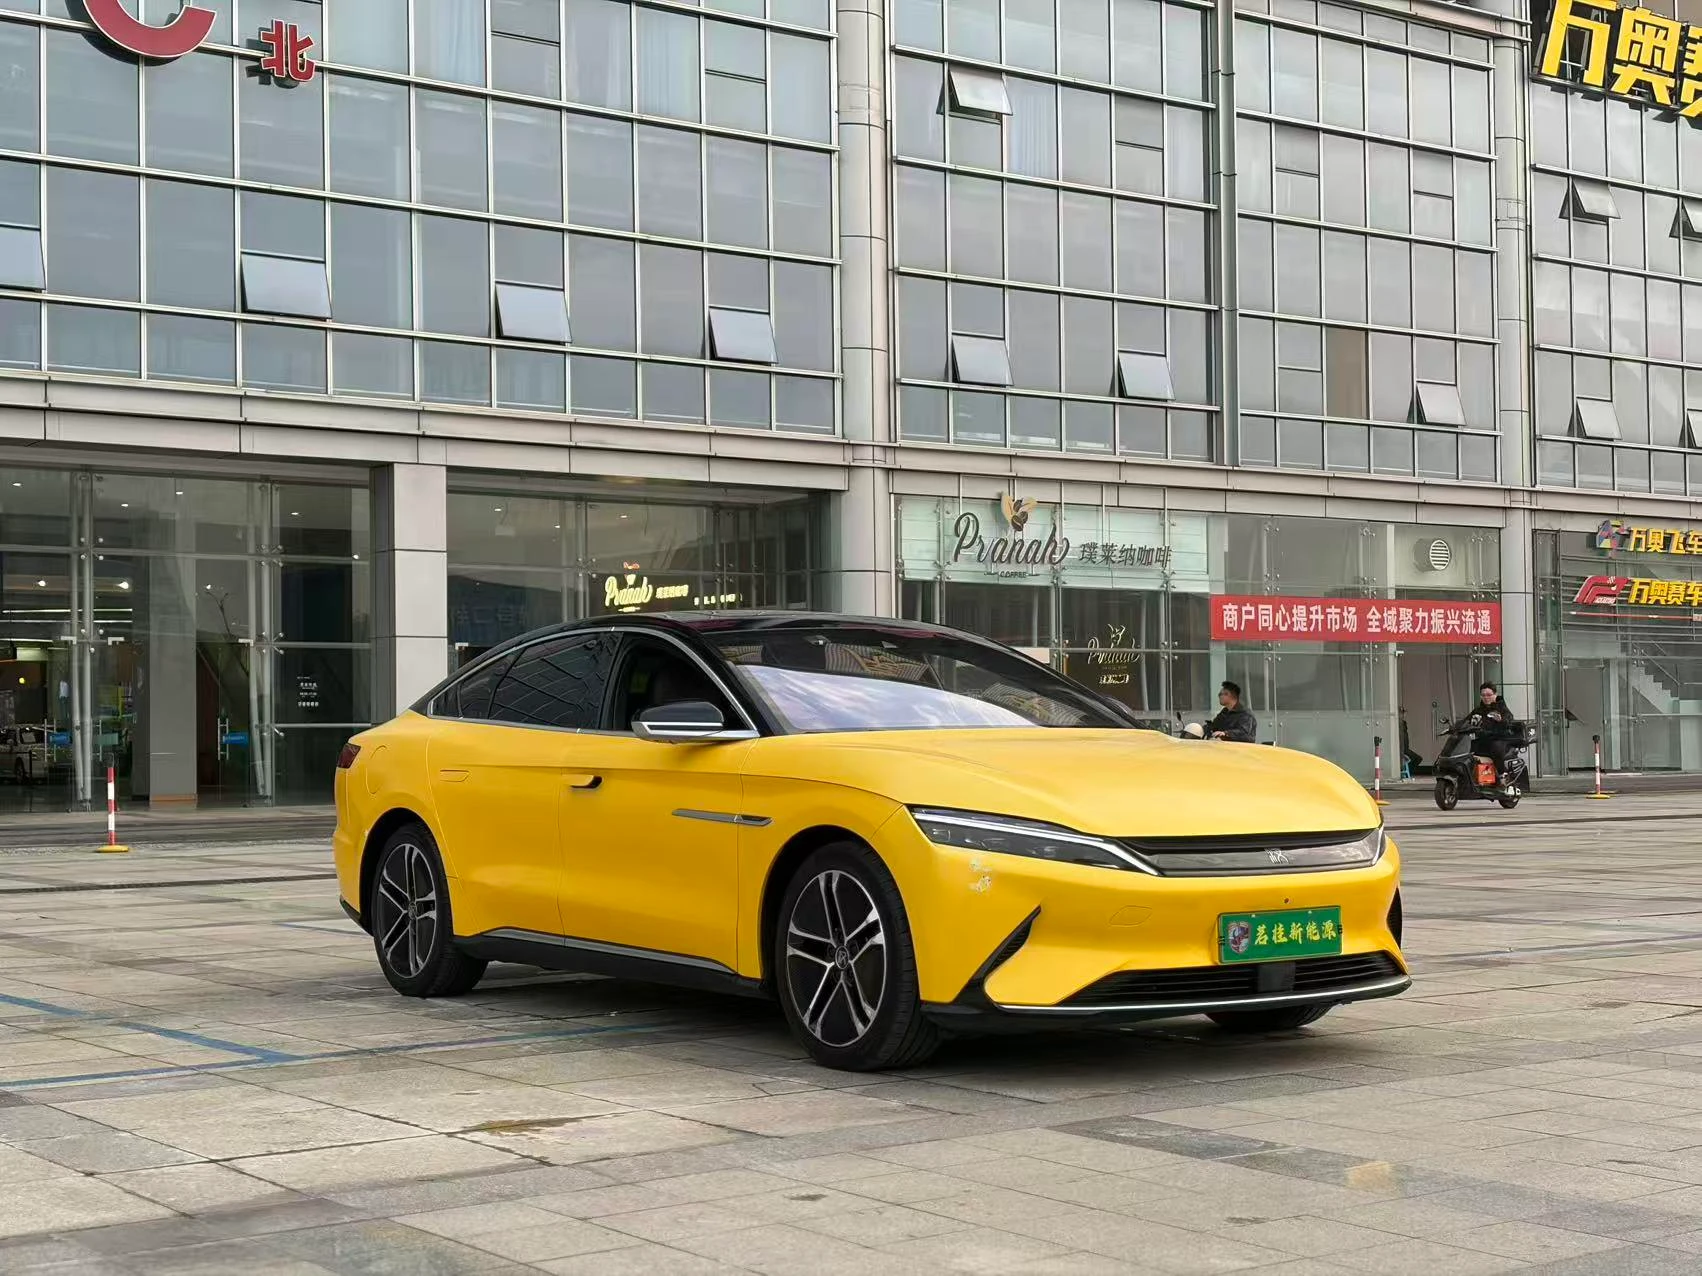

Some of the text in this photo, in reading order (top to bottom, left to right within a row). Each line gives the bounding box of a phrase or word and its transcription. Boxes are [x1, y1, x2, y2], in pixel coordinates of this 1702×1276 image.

[261, 19, 316, 82] 北
[1079, 543, 1172, 568] 璞莱纳咖啡
[1222, 603, 1492, 635] 商户同心提升市场 全域聚力振兴流通
